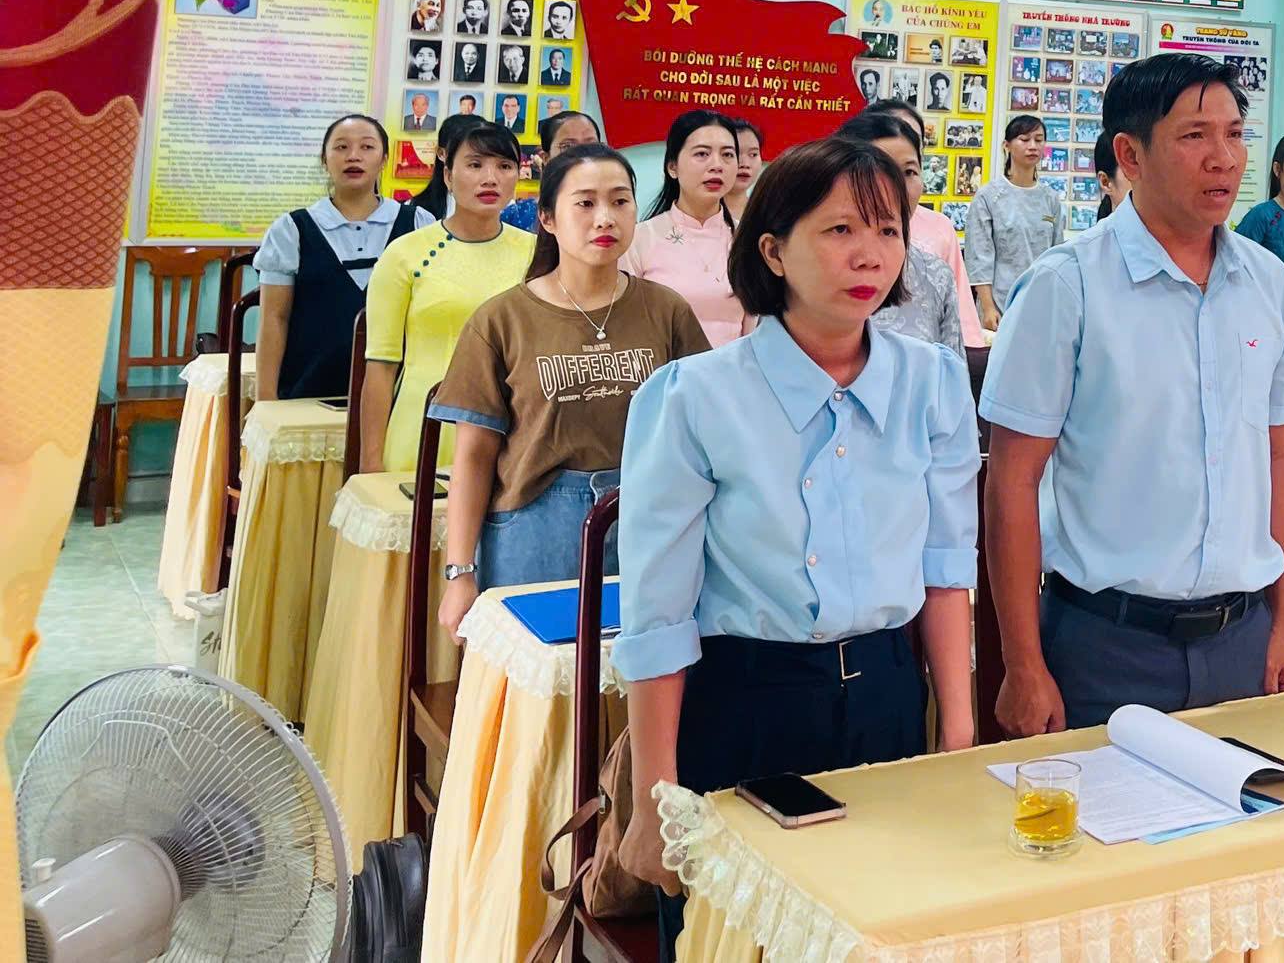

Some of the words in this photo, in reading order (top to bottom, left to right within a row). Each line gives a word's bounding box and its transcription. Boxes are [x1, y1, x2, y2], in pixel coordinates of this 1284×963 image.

[941, 6, 965, 17] KÍNH
[967, 22, 981, 30] EM
[718, 51, 743, 68] THẾ
[747, 55, 763, 73] HỆ
[766, 55, 800, 72] CÁCH
[660, 70, 687, 84] CHO
[690, 70, 713, 85] ĐỜI
[715, 73, 740, 87] SAU
[744, 73, 760, 88] LÀ
[763, 75, 789, 93] MỘT
[792, 79, 821, 95] VIỆC
[623, 84, 648, 100] RẤT
[653, 89, 689, 103] QUAN
[692, 92, 736, 108] TRỌNG
[740, 94, 756, 107] VÀ
[815, 96, 851, 112] THIẾT
[536, 348, 655, 401] DIFFERENT
